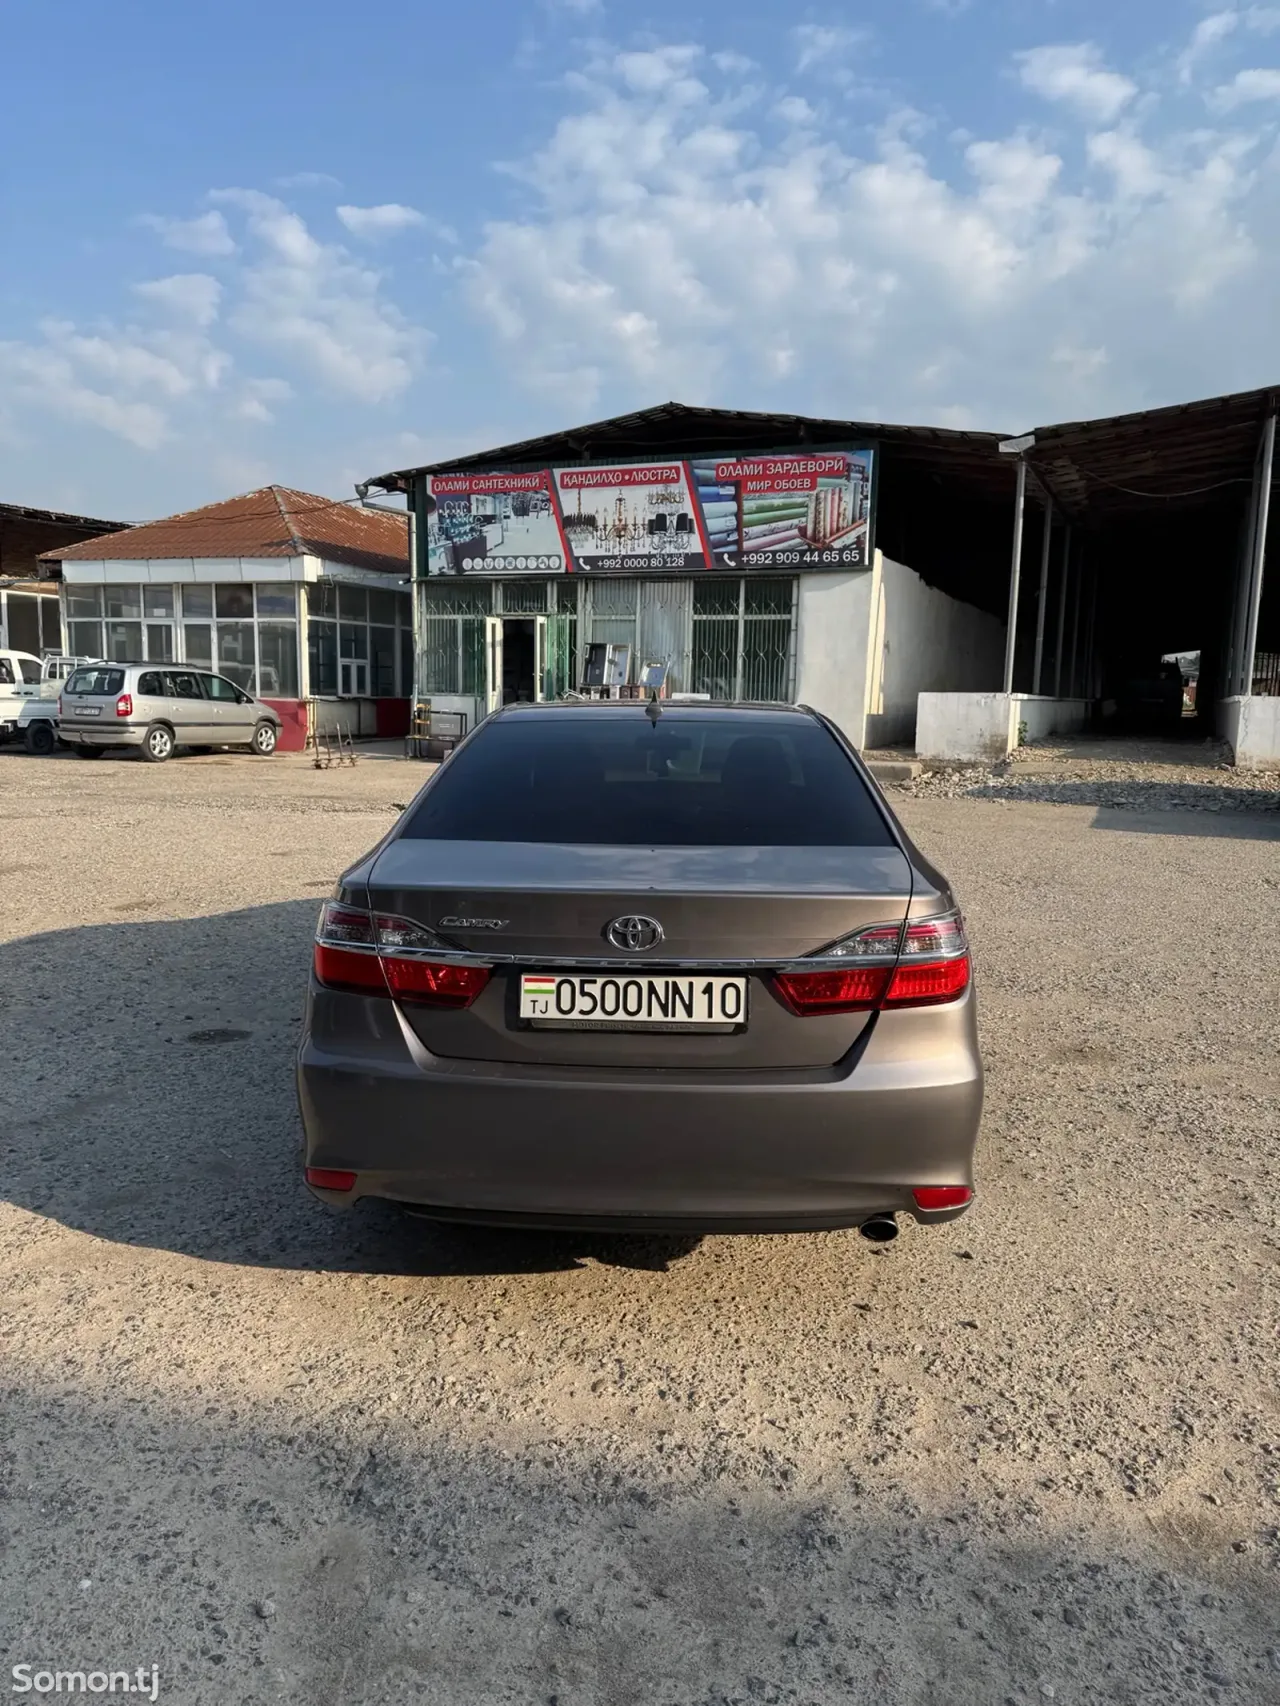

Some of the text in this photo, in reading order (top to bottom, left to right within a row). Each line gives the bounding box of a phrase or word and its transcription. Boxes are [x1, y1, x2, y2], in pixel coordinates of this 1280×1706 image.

[631, 469, 678, 482] ЛЮСТРА
[718, 463, 763, 477] ОЛАМИ
[434, 480, 470, 492] ОЛАМИ
[747, 478, 811, 491] МИР ОБОЕВ
[597, 557, 685, 568] +992 0000 80 128
[741, 550, 860, 564] +992 909 44 65 65
[530, 1000, 549, 1015] TJ
